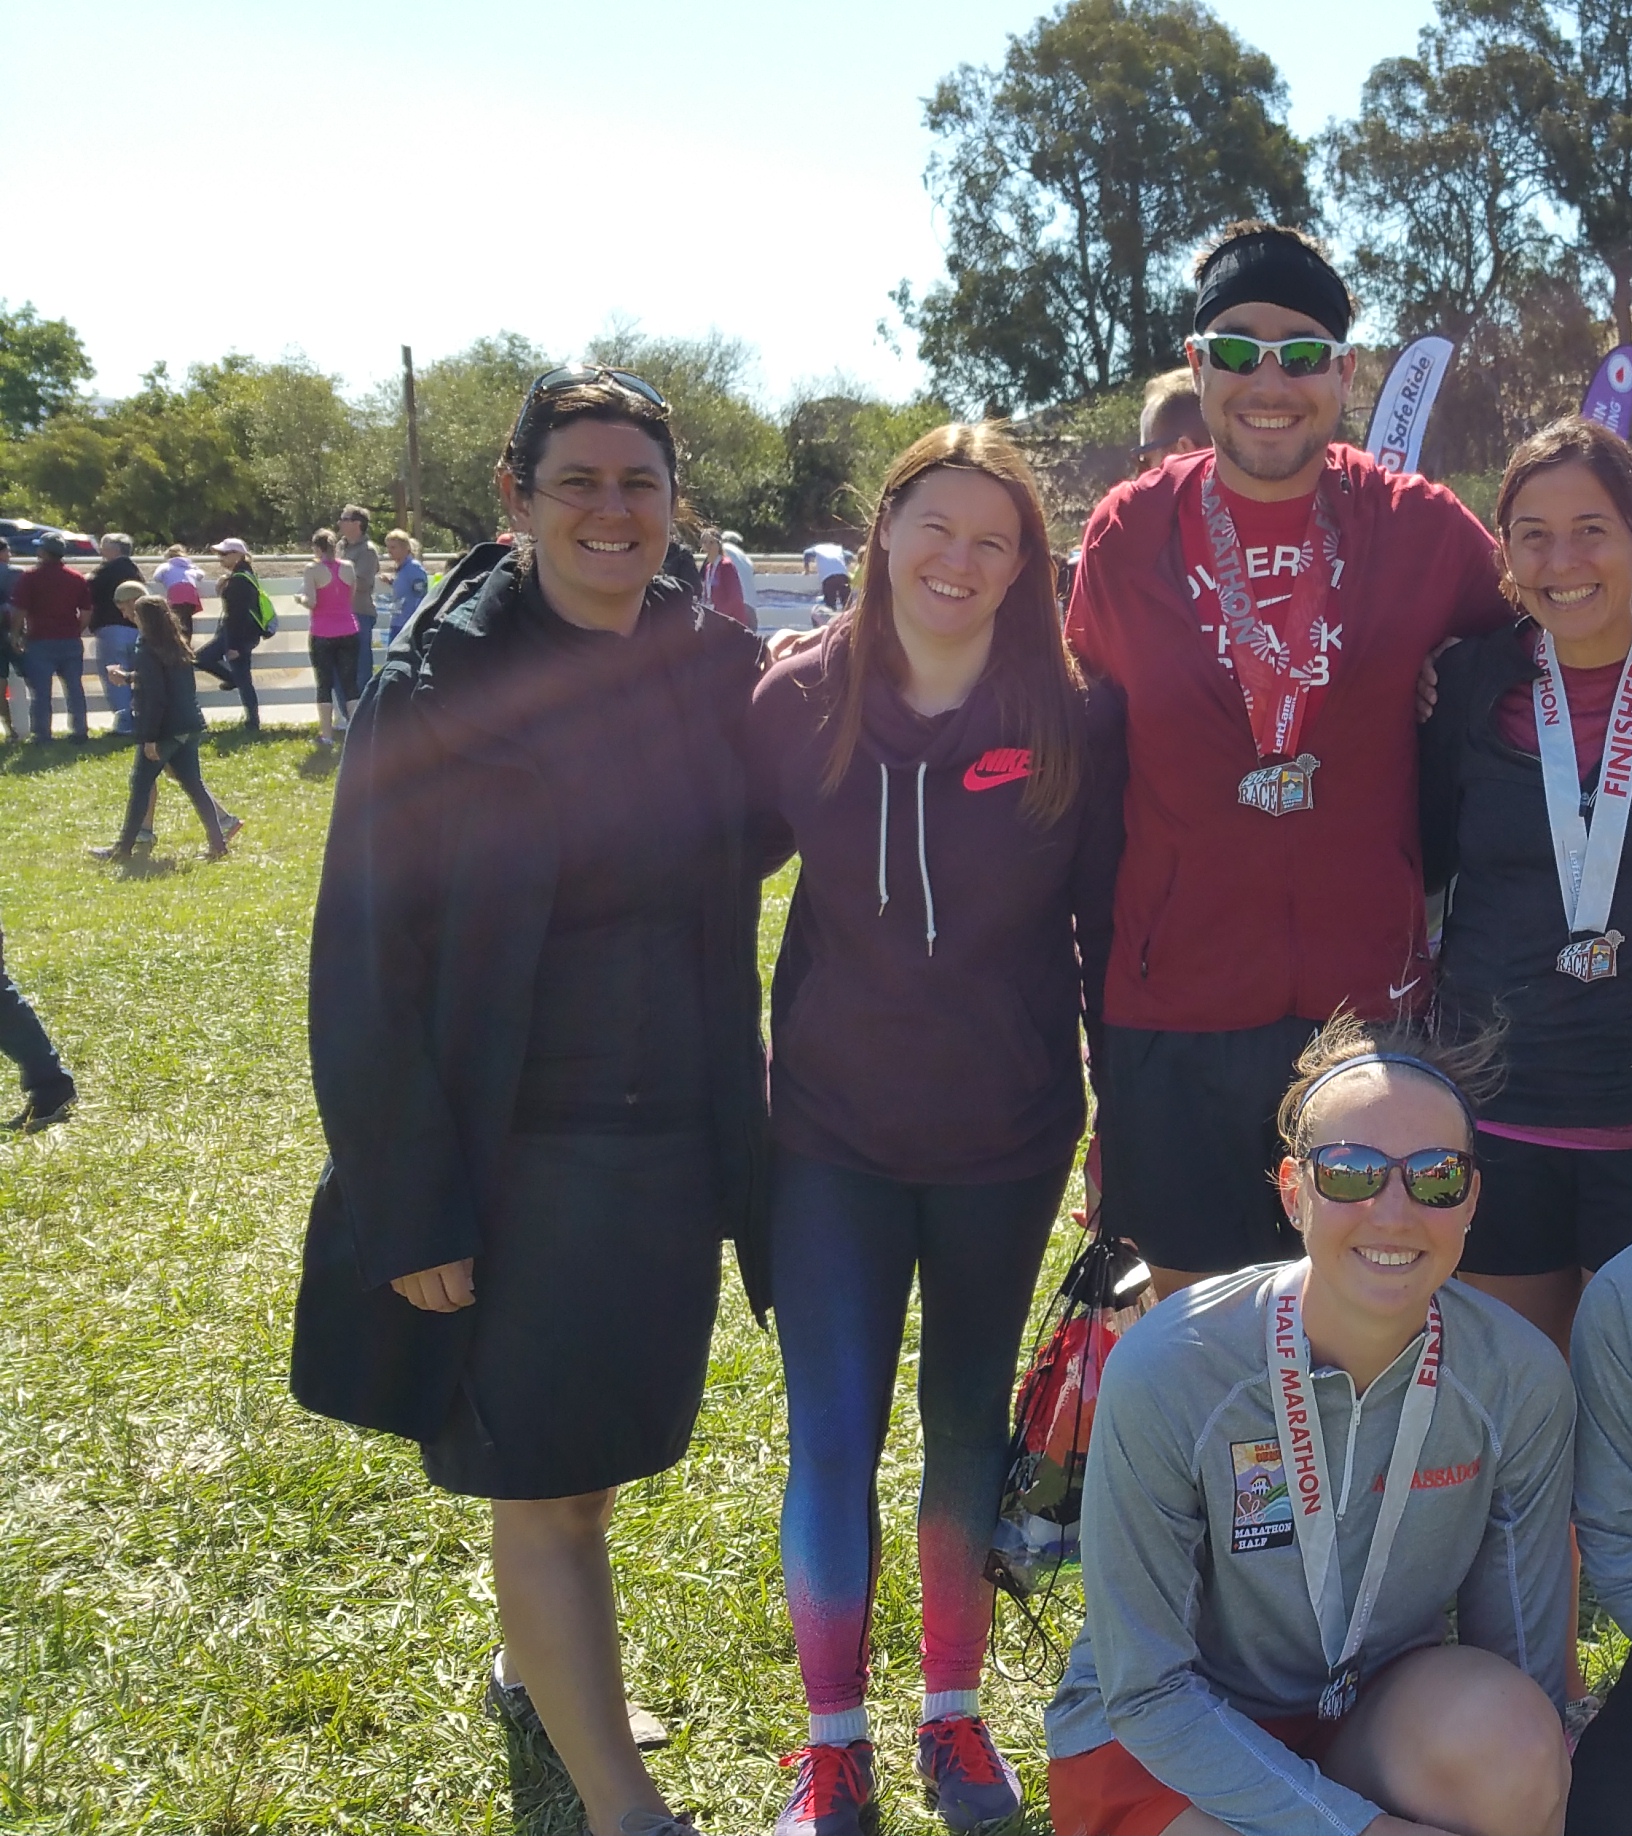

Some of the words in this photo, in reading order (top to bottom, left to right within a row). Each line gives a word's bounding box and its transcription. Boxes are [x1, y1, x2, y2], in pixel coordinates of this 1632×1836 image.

[1387, 404, 1413, 448] Safe
[1401, 356, 1430, 403] Ride
[977, 748, 1033, 772] NIKE
[1240, 780, 1278, 813] RACE
[1558, 955, 1588, 977] RACE
[1275, 1295, 1297, 1359] HALF
[1280, 1368, 1322, 1516] MARATHON
[1234, 1522, 1293, 1539] MARATHON
